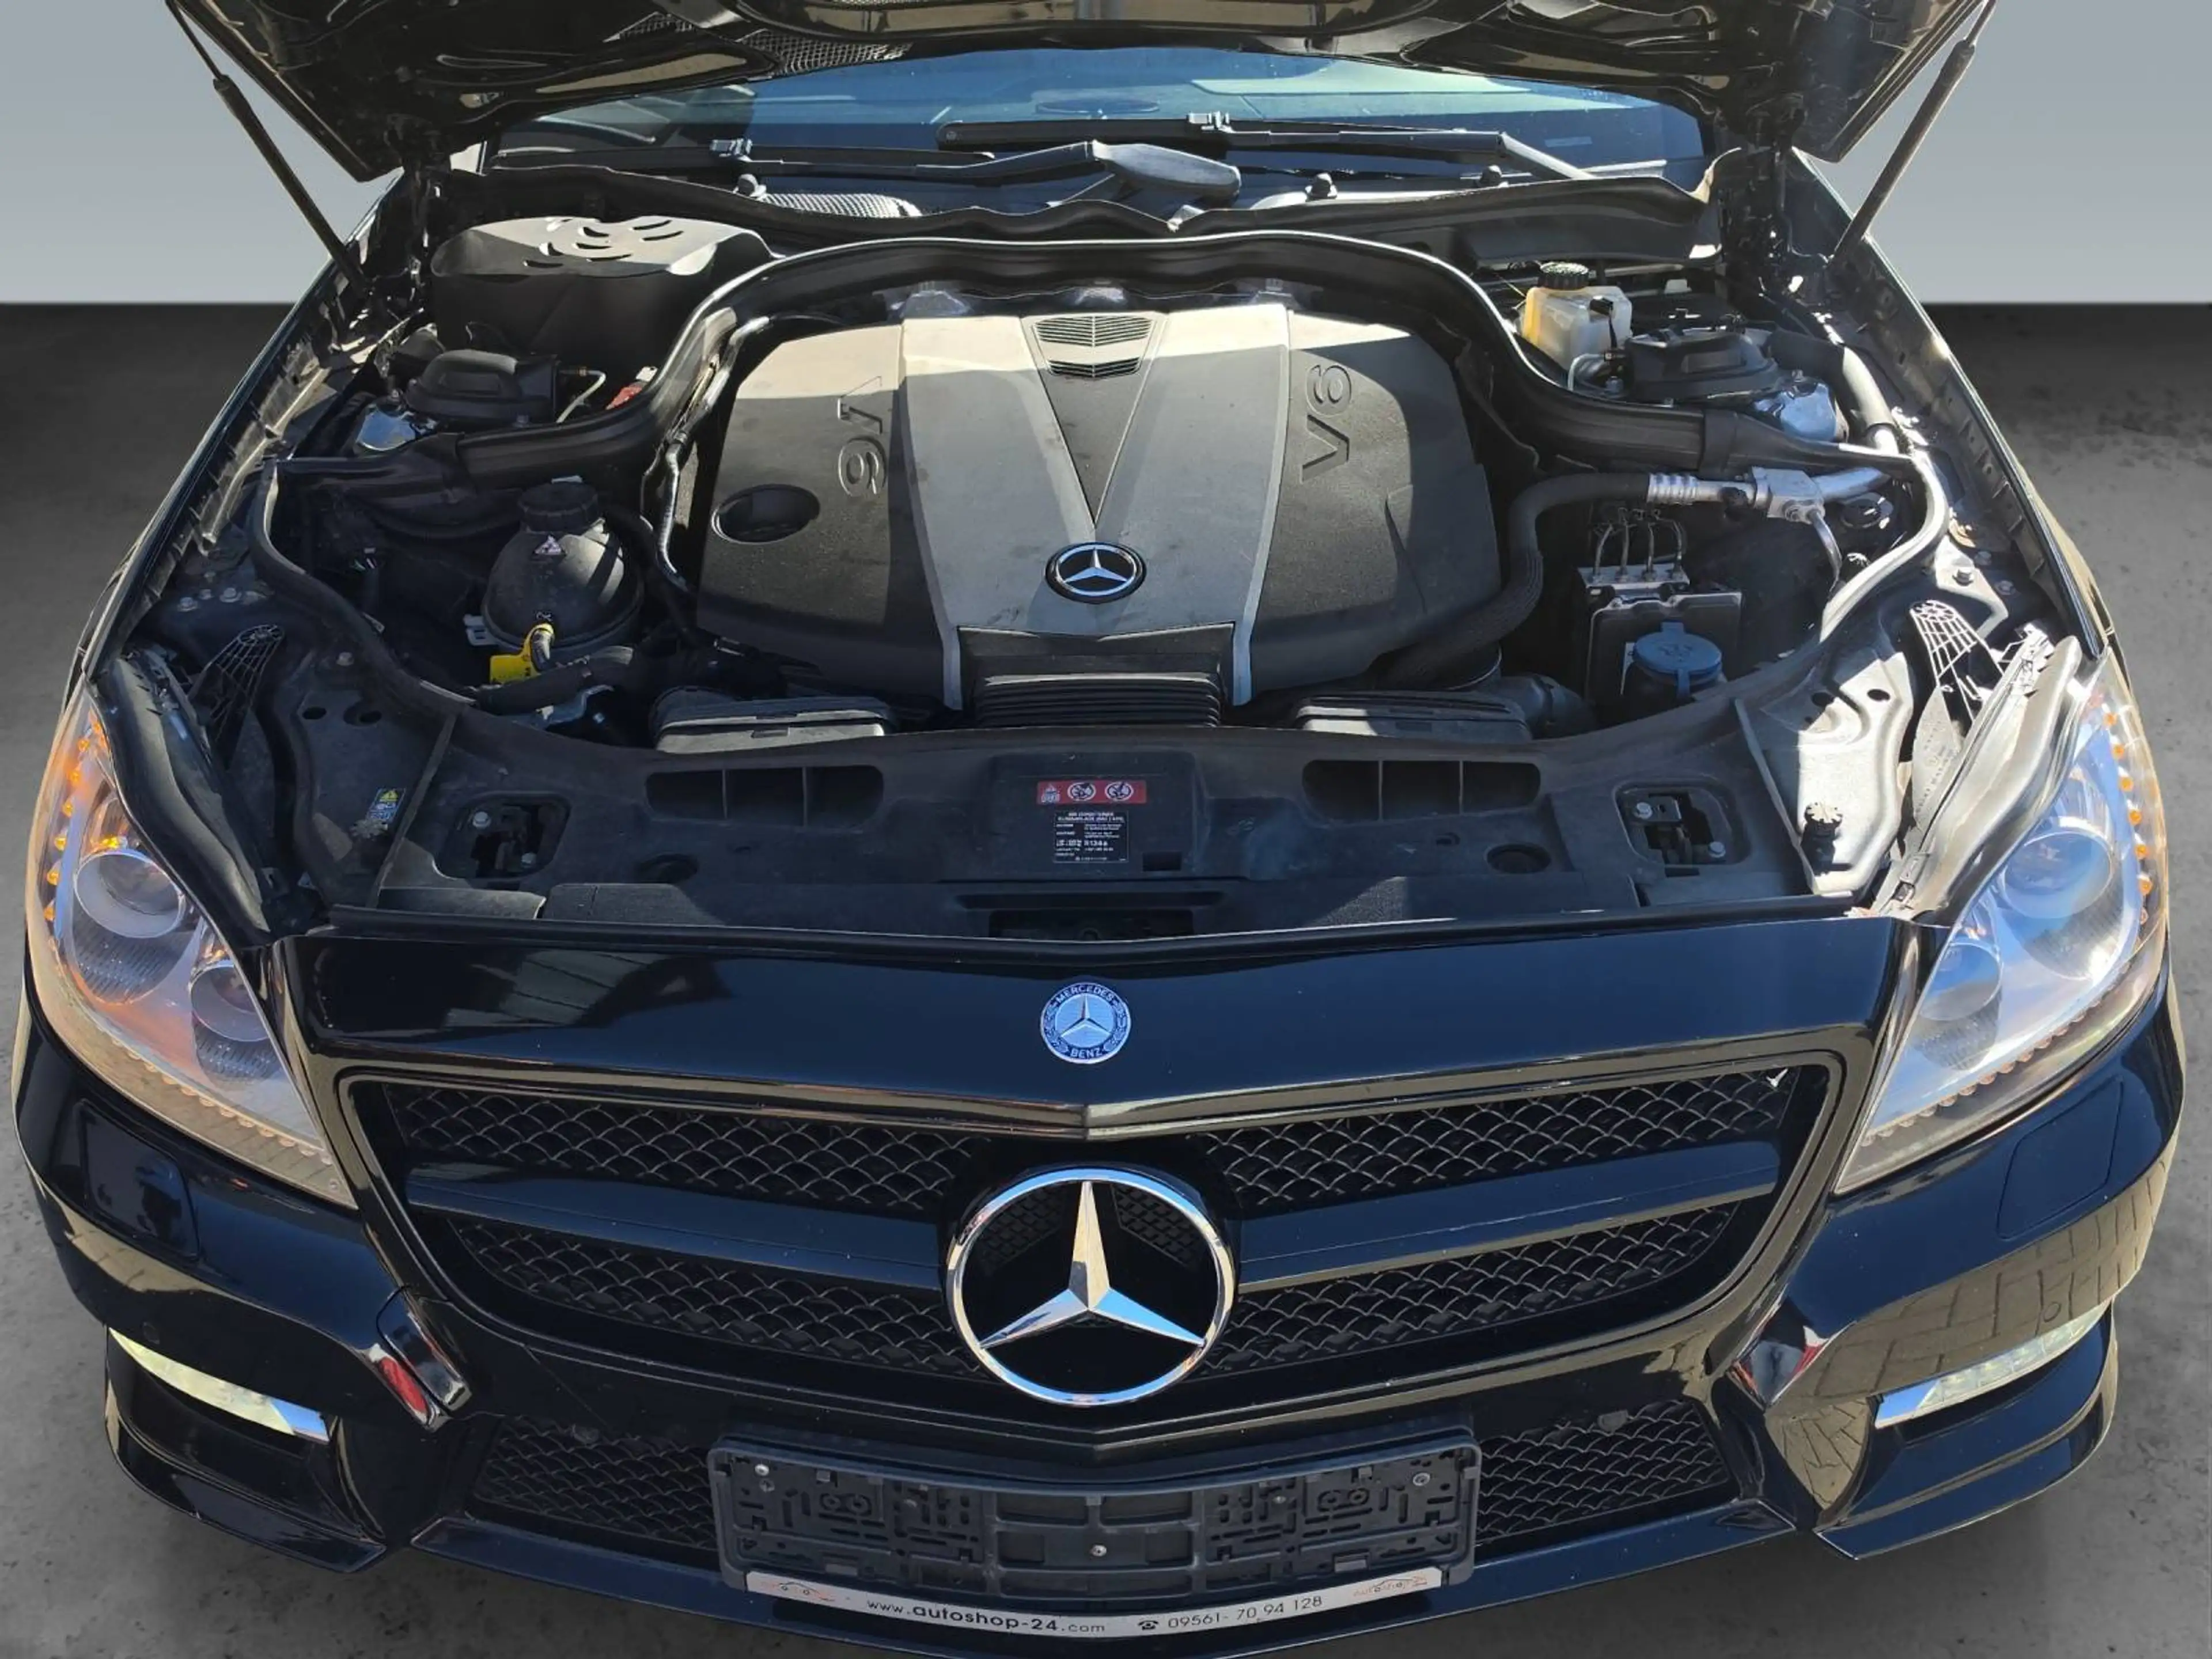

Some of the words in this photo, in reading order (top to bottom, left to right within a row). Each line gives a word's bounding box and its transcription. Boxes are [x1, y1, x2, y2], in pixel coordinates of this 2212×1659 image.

[836, 376, 887, 497] V6
[1300, 364, 1352, 484] V6
[1056, 986, 1114, 1003] MERCEDES
[1070, 1047, 1104, 1059] BENZ
[867, 1600, 1105, 1633] www.autoshop-24.com
[1236, 1608, 1257, 1620] 70
[1263, 1603, 1284, 1616] 94
[1294, 1596, 1323, 1611] 128
